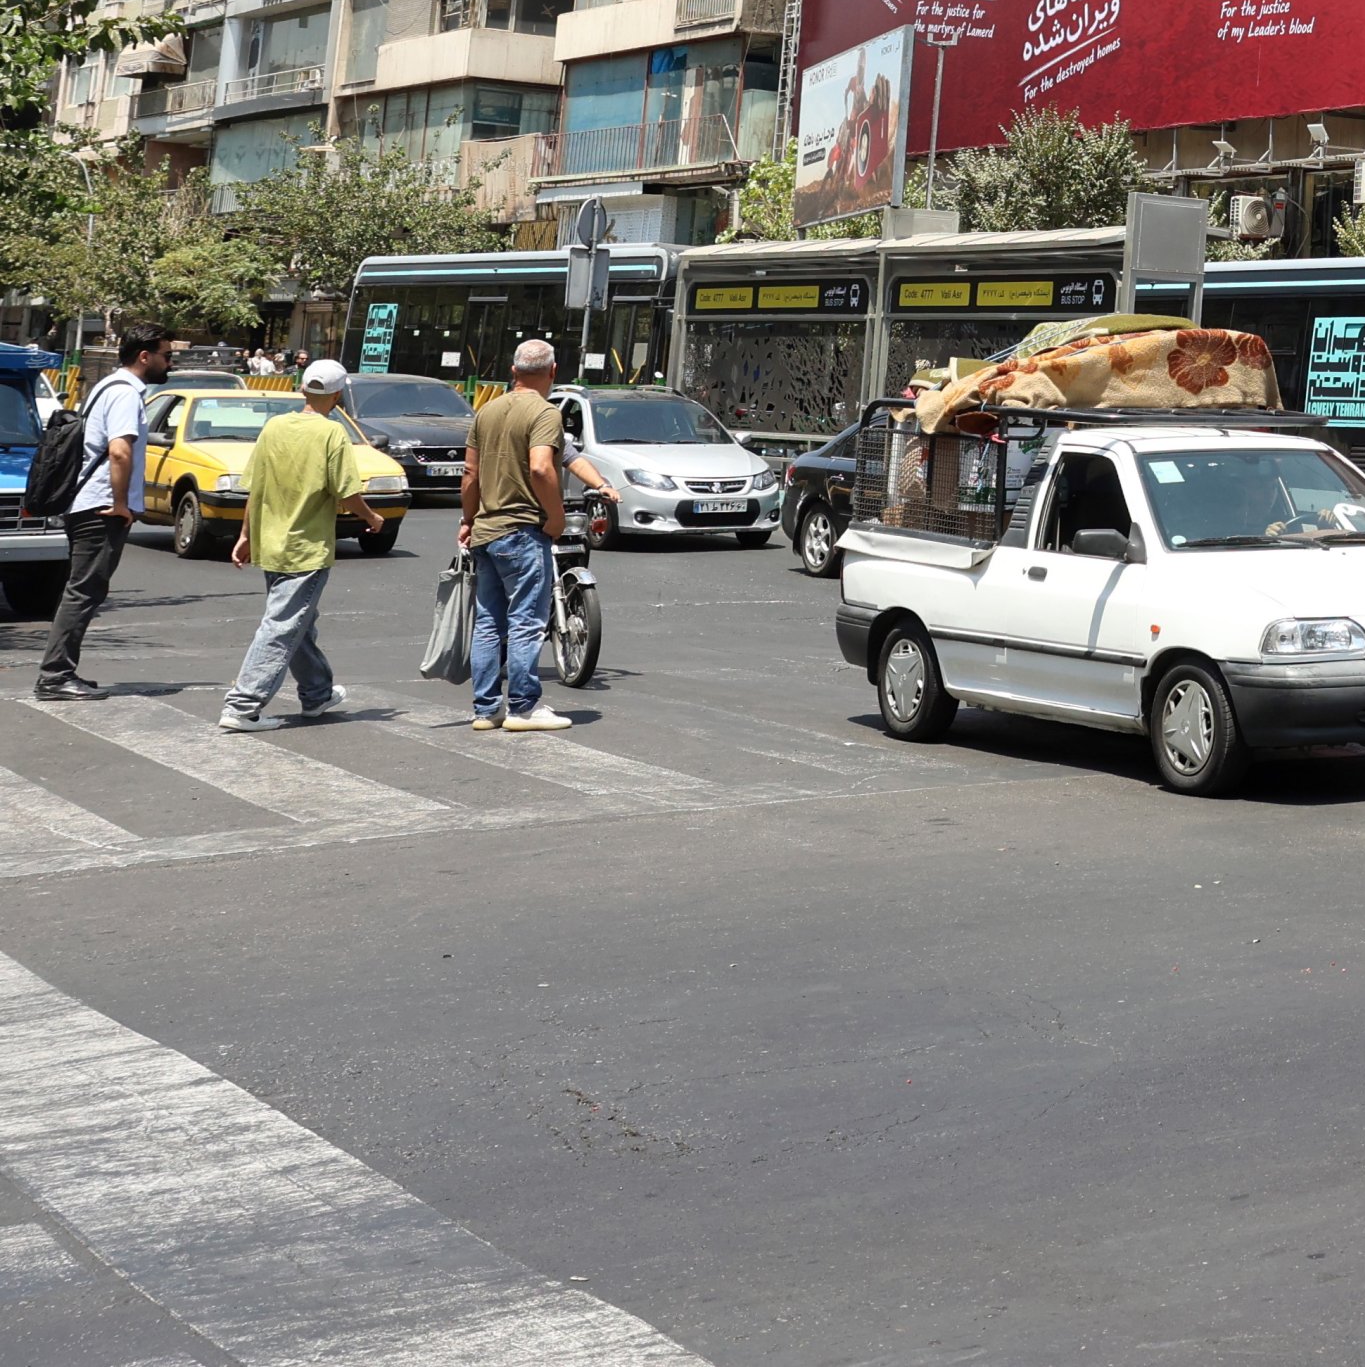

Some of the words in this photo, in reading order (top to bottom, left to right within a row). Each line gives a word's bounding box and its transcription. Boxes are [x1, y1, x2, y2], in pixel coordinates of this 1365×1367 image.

[916, 1, 929, 15] For
[932, 1, 945, 20] the
[946, 3, 969, 19] justice
[973, 4, 985, 19] for
[1221, 1, 1237, 18] For
[1241, 0, 1255, 16] the
[1257, 0, 1290, 19] justice
[913, 19, 925, 37] the
[928, 22, 956, 39] martyrs
[957, 22, 966, 38] of
[967, 23, 995, 38] Lamerd
[1023, 26, 1065, 61] شده
[1025, 85, 1038, 103] For
[1040, 76, 1053, 92] the
[1056, 49, 1094, 83] destroyed
[1097, 38, 1120, 59] homes
[920, 289, 934, 300] 4777
[952, 289, 963, 300] Asr
[1060, 295, 1072, 305] BUS
[1072, 295, 1086, 305] STOP
[1307, 401, 1335, 417] LOVELY
